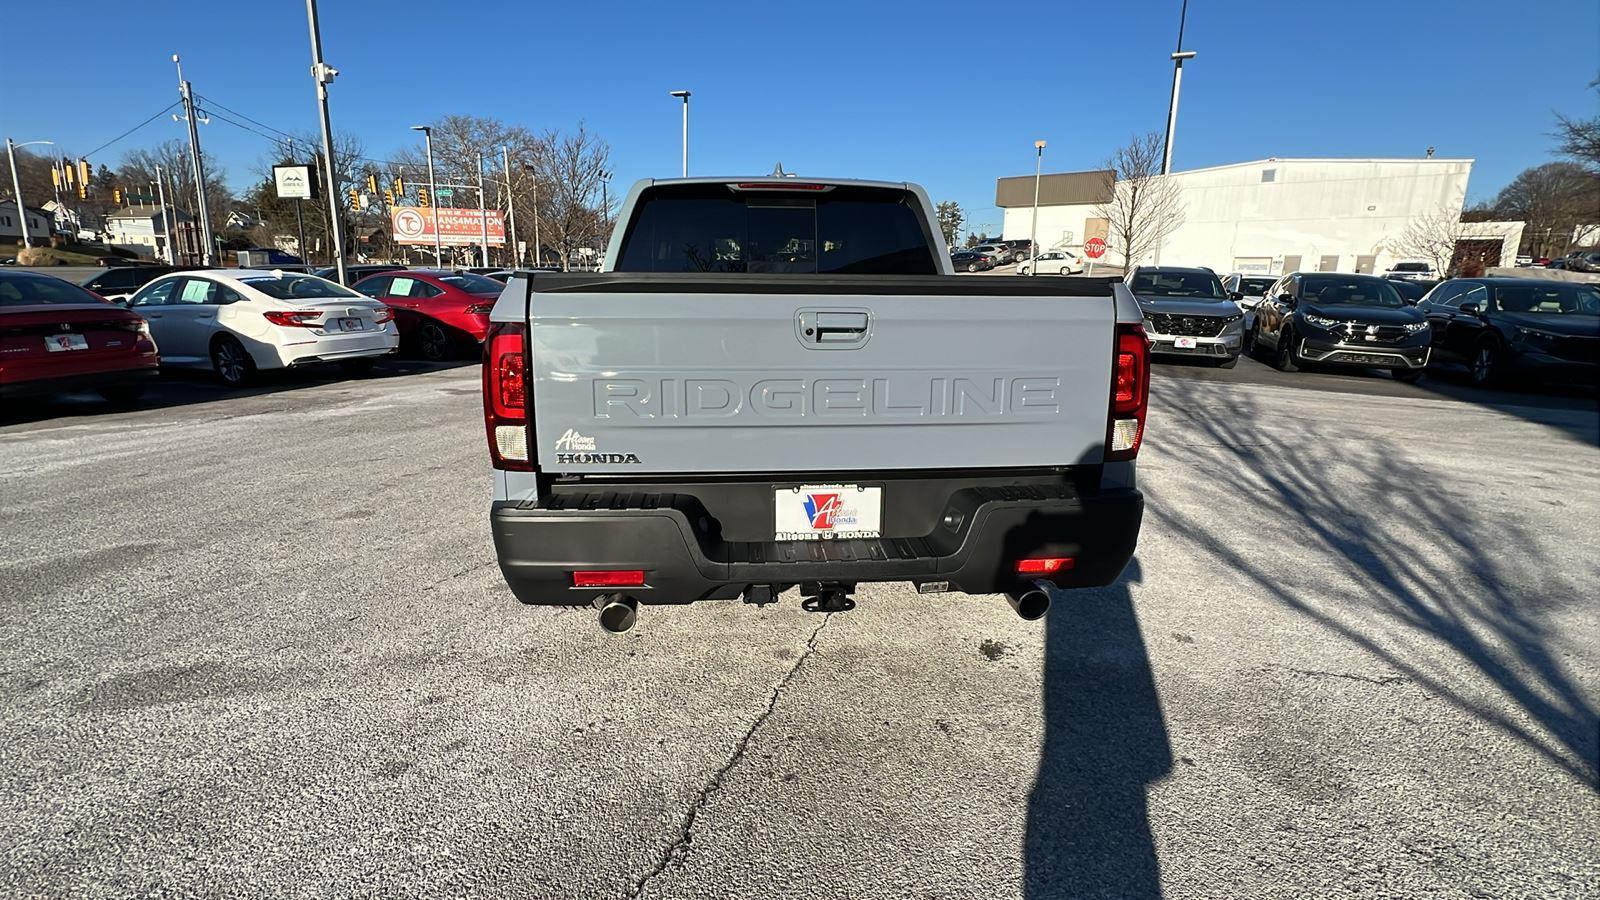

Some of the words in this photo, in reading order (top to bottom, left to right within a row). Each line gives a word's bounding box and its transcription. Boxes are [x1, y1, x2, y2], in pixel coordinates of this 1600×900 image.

[426, 215, 502, 225] TANS4MATON
[1085, 243, 1105, 253] STOP
[592, 377, 1061, 419] RIDGELINE
[572, 442, 596, 451] Honda
[557, 453, 642, 464] HONDA
[775, 531, 819, 541] Altoona
[837, 530, 880, 539] HONDA
